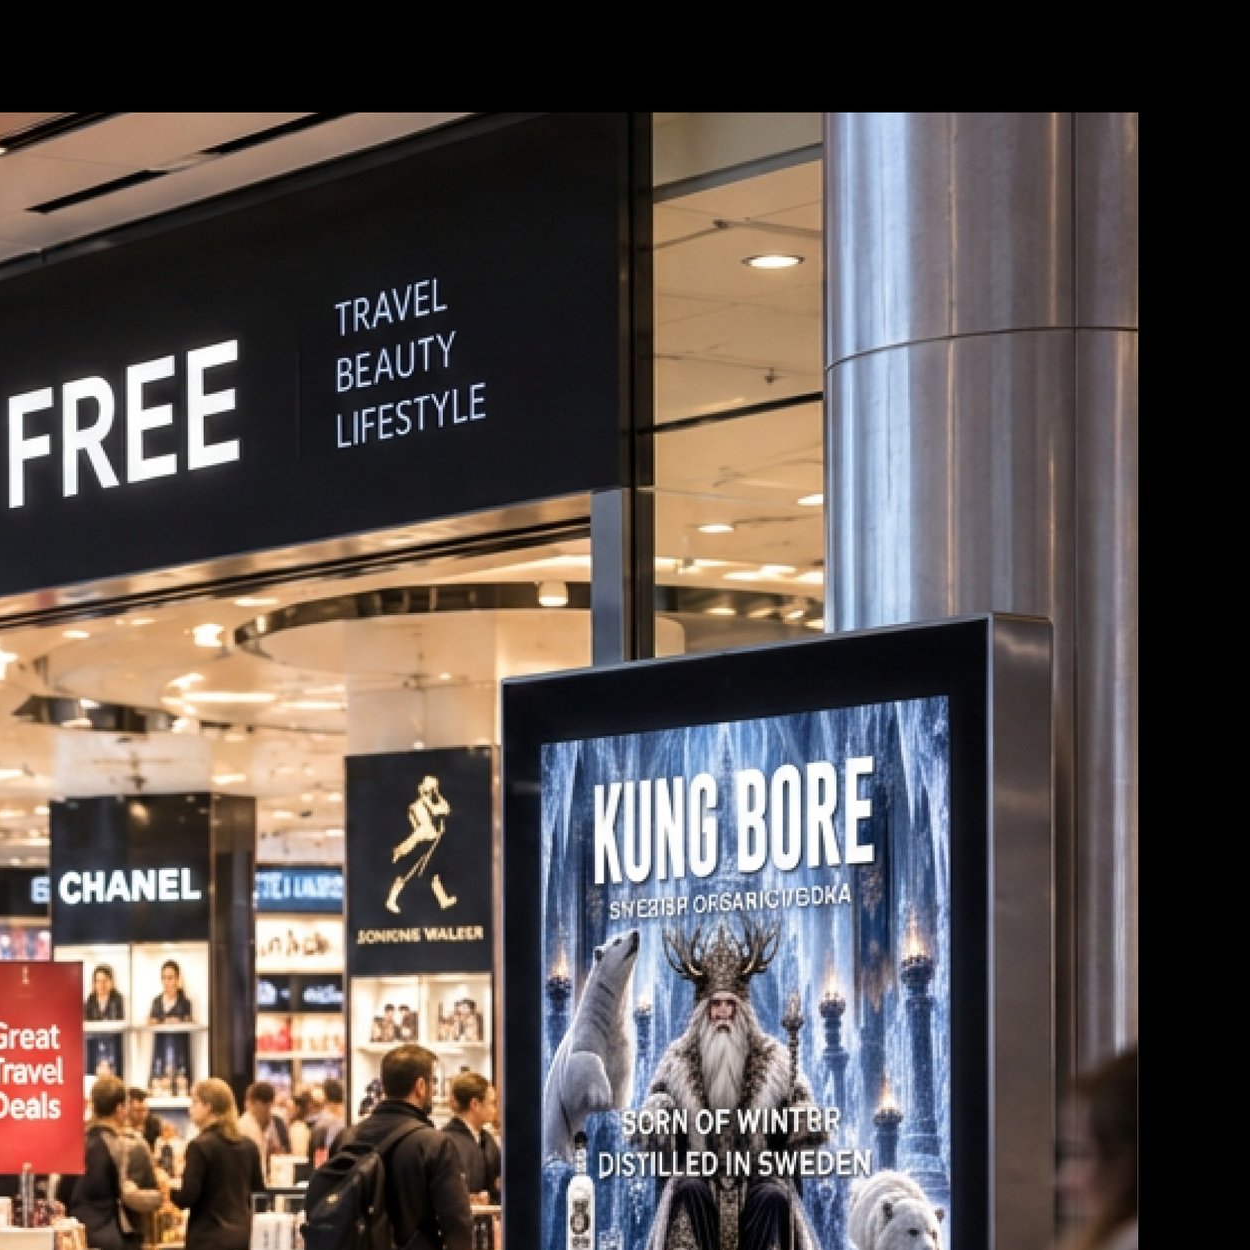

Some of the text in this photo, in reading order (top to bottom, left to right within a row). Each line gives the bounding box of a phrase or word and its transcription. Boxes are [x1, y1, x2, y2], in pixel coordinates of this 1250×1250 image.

[334, 277, 447, 337] TRAVEL
[335, 331, 457, 393] BEAUTY
[7, 339, 241, 509] FREE
[336, 382, 488, 450] LIFESTYLE
[593, 756, 876, 885] KUNG BORE
[58, 867, 202, 905] CHANEL
[695, 1108, 730, 1135] OF
[598, 1150, 872, 1179] DISTILLED IN SWEDEN
